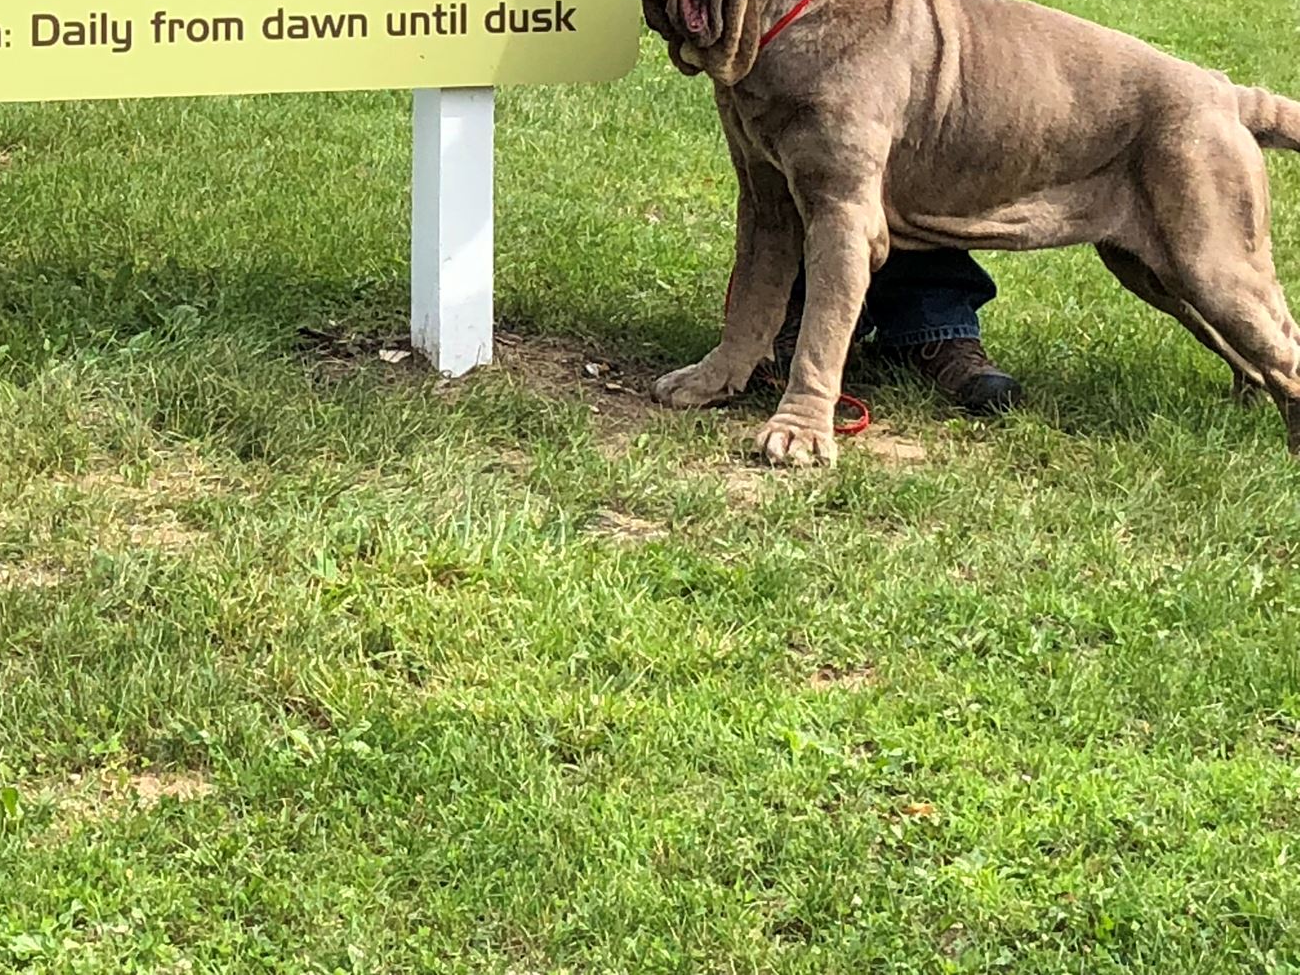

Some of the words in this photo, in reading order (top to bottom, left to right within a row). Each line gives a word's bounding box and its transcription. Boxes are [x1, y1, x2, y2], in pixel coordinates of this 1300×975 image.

[31, 12, 133, 54] Daily
[150, 11, 244, 43] from
[262, 8, 368, 40] dawn
[386, 3, 468, 37] until
[484, 0, 578, 34] dusk
